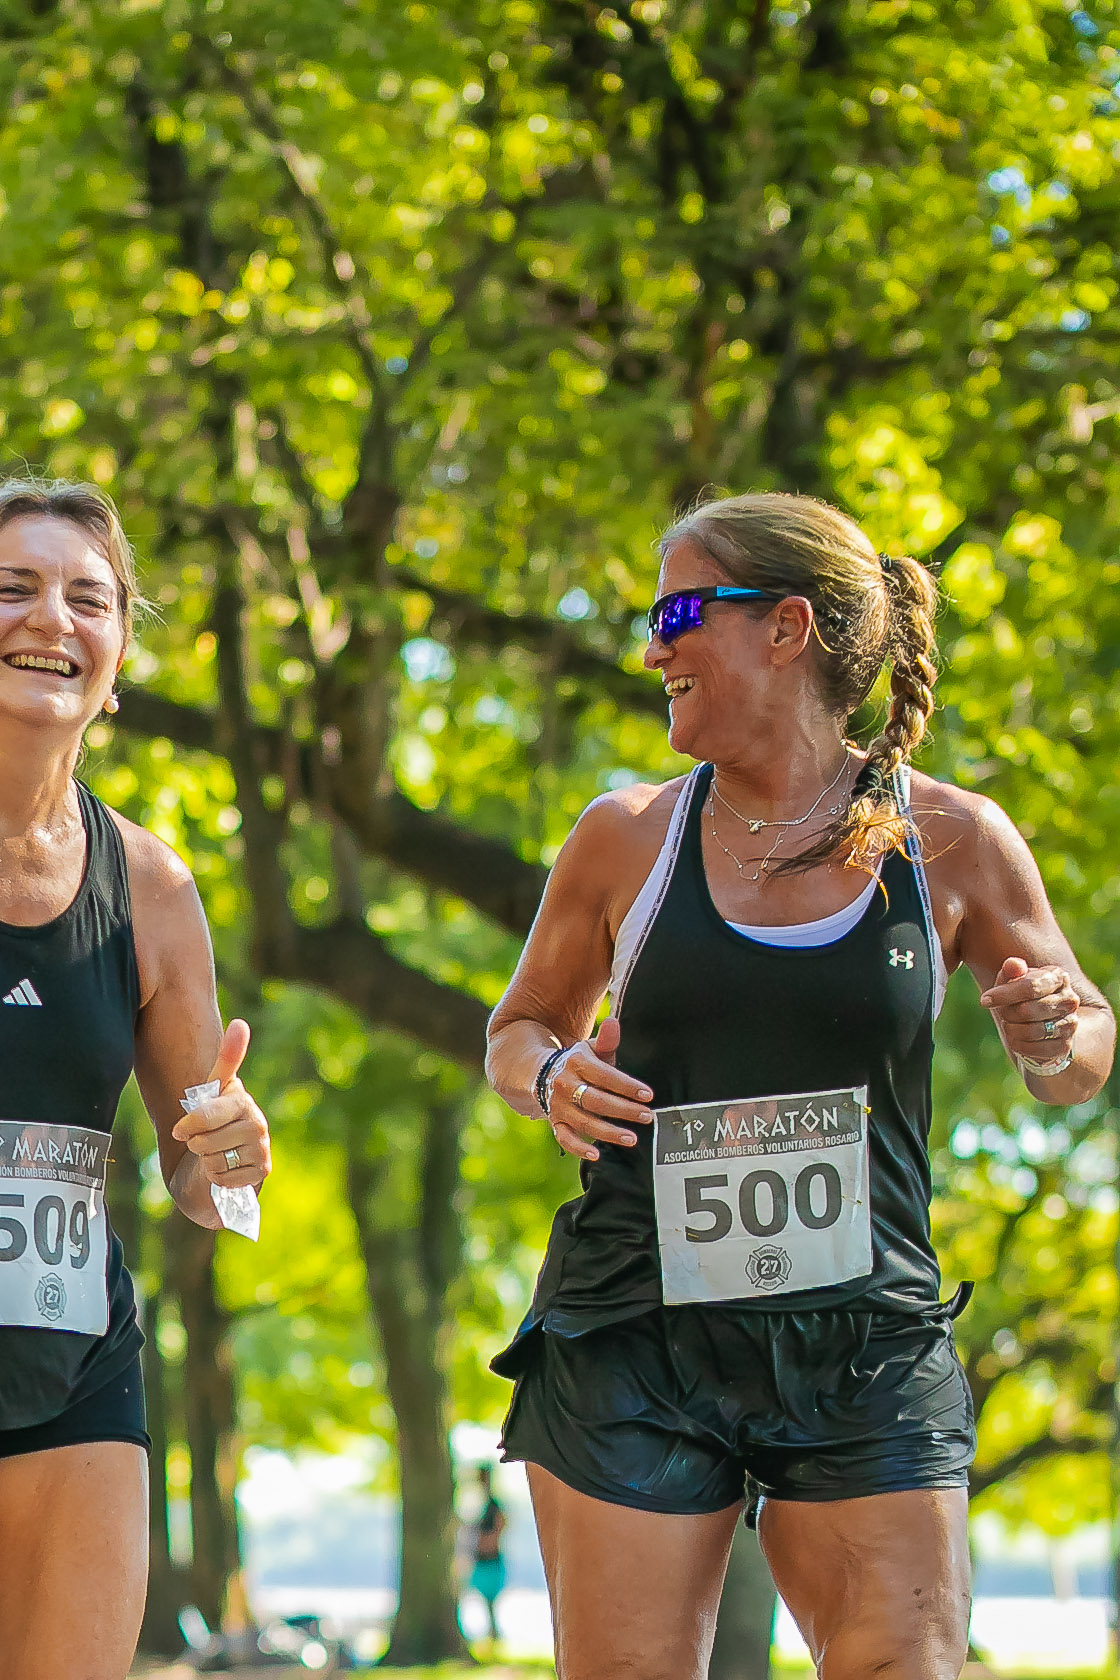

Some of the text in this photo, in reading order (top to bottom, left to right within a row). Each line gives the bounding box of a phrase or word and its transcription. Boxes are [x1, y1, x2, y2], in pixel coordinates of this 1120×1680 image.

[714, 1102, 838, 1141] MARATÓN
[12, 1136, 98, 1168] MARATÓN
[663, 1131, 860, 1164] ASOCIACIÓN BOMBEROS VOLUNTARIOS ROSARIO
[14, 1165, 58, 1180] BOMBEROS
[684, 1163, 842, 1242] 500
[760, 1259, 779, 1275] 27
